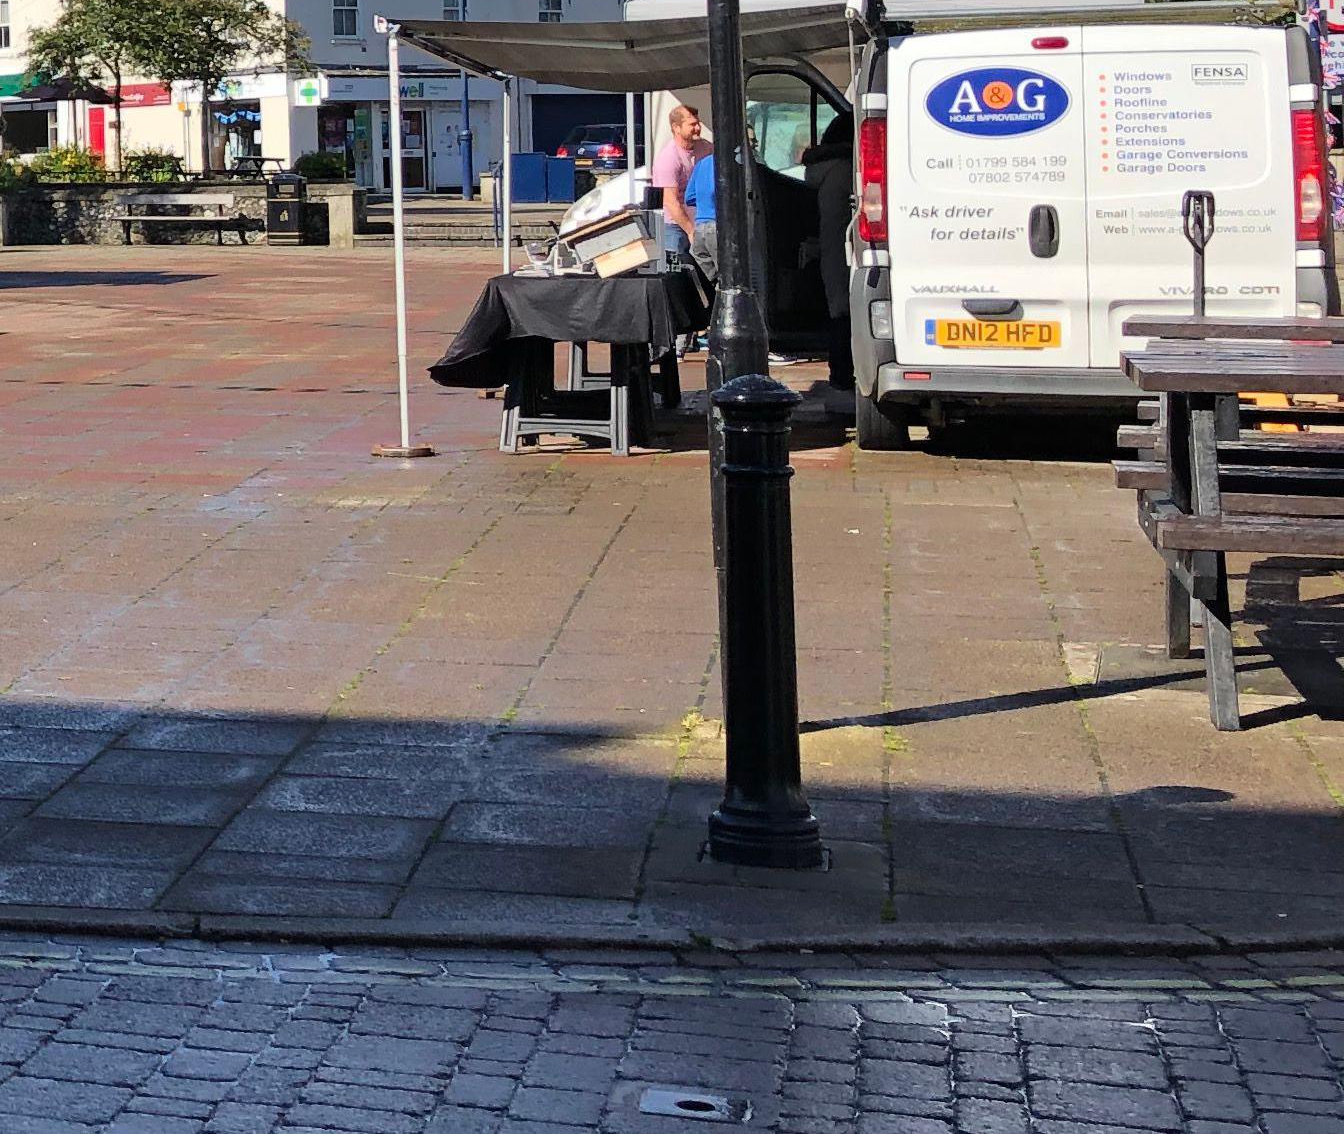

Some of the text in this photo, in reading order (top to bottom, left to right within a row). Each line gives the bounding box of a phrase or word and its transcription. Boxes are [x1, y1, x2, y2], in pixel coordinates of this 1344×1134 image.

[1114, 72, 1172, 81] Windows
[1194, 67, 1244, 77] FENSA
[1114, 85, 1152, 94] Doors
[1114, 98, 1167, 107] Roofline
[949, 112, 1045, 123] HOME IMPROVEMENTS
[1115, 110, 1212, 120] Conservatories
[1115, 124, 1167, 133] Porches
[1115, 137, 1185, 146] Extensions
[1116, 149, 1248, 161] Garage Conversions
[926, 155, 1067, 169] Call 01799 584 199
[1117, 163, 1206, 174] Garage Doors
[968, 171, 1065, 184] 07802 574789
[945, 206, 994, 218] driver
[1096, 209, 1127, 218] Email
[931, 228, 954, 240] for
[1104, 225, 1129, 234] Web
[911, 285, 999, 294] VAUXHALL
[947, 323, 1052, 342] DN12 HFD
